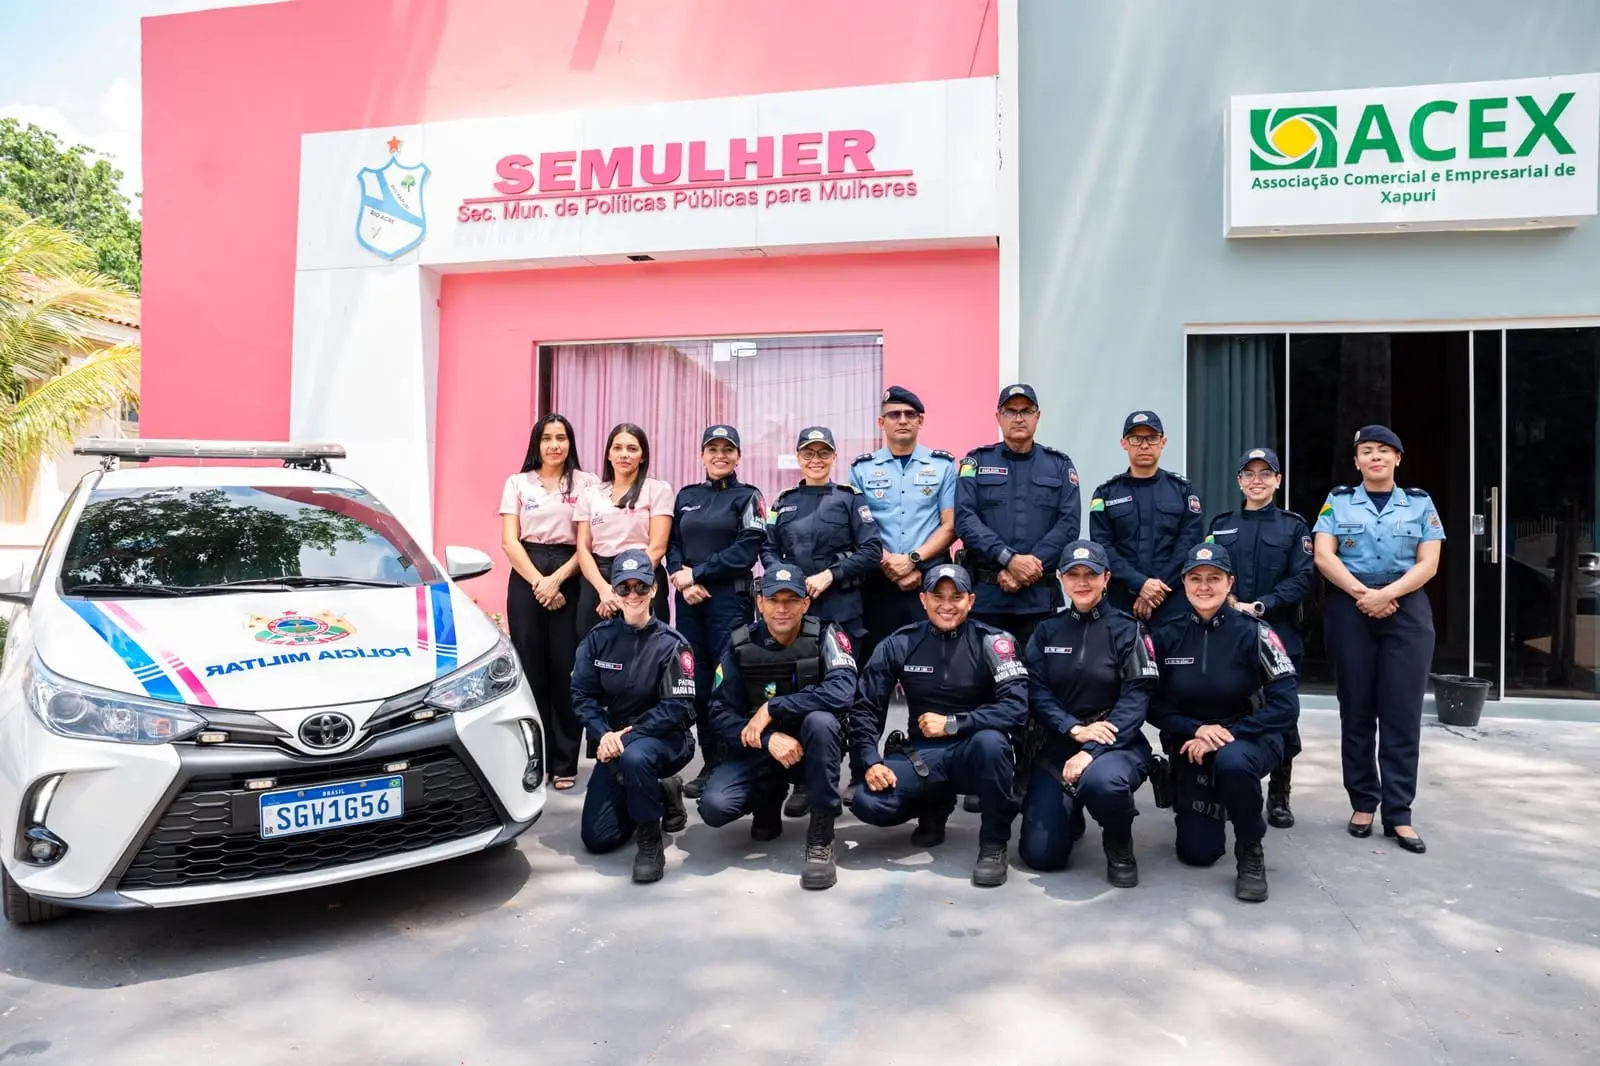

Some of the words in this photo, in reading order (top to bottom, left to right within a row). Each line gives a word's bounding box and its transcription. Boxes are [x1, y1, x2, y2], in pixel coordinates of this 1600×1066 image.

[1344, 92, 1577, 164] ACEX
[494, 129, 876, 195] SEMULHER
[1251, 173, 1339, 190] Associação
[1344, 169, 1426, 185] Comercial
[1431, 172, 1440, 182] e
[1446, 164, 1548, 183] Empresarial
[1554, 162, 1576, 176] de
[457, 204, 496, 223] Sec.
[504, 201, 548, 220] Mun.
[555, 199, 578, 217] de
[585, 193, 666, 215] Políticas
[673, 187, 759, 209] Públicas
[765, 187, 811, 208] para
[819, 180, 918, 201] Mulheres
[1381, 188, 1436, 205] Xapuri
[370, 209, 380, 218] RIO
[322, 789, 345, 797] BRASIL
[277, 792, 390, 831] SGW1G56
[264, 826, 274, 835] BR
